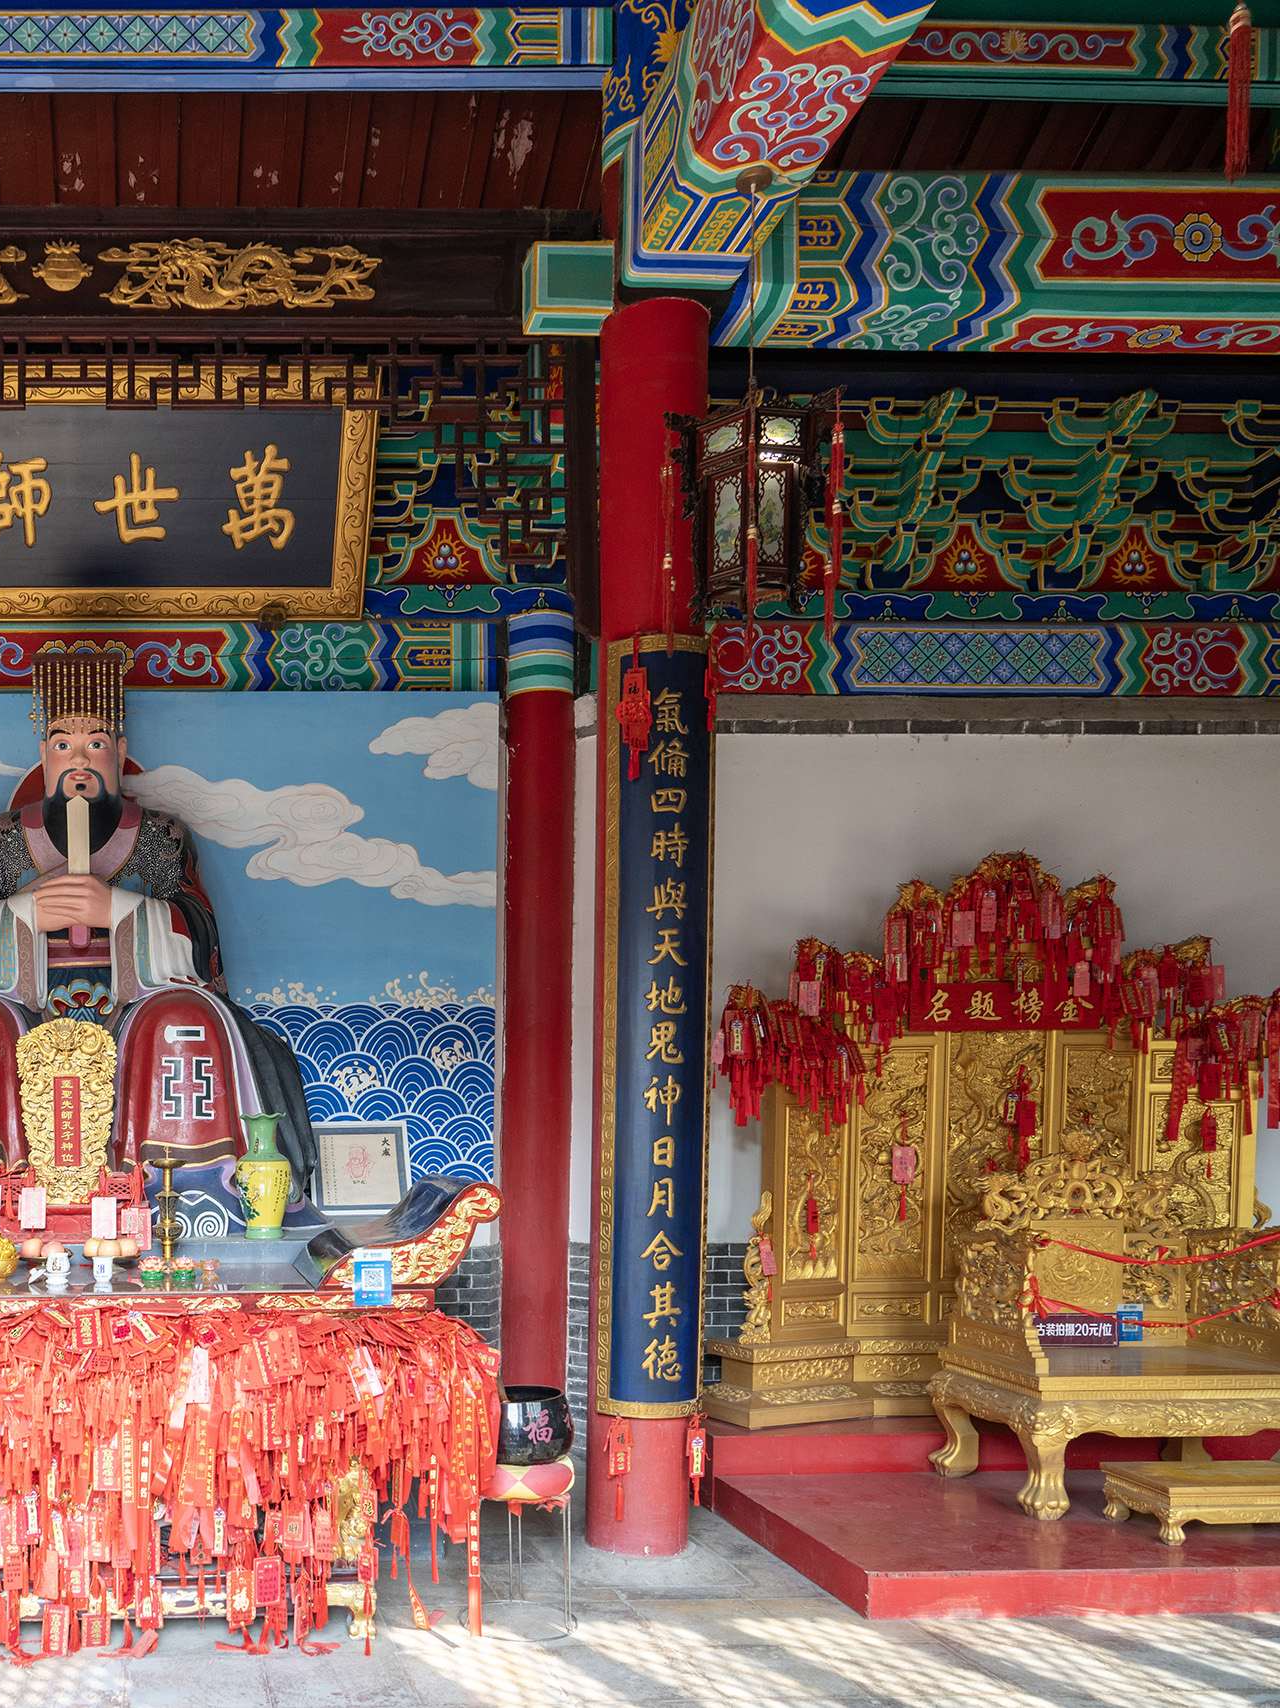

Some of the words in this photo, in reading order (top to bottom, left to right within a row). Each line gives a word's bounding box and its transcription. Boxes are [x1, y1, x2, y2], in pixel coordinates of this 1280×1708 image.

[627, 681, 640, 695] 福
[1036, 1322, 1113, 1337] 古装拍摄20元/位
[523, 1408, 554, 1445] 福
[232, 1586, 250, 1612] 福
